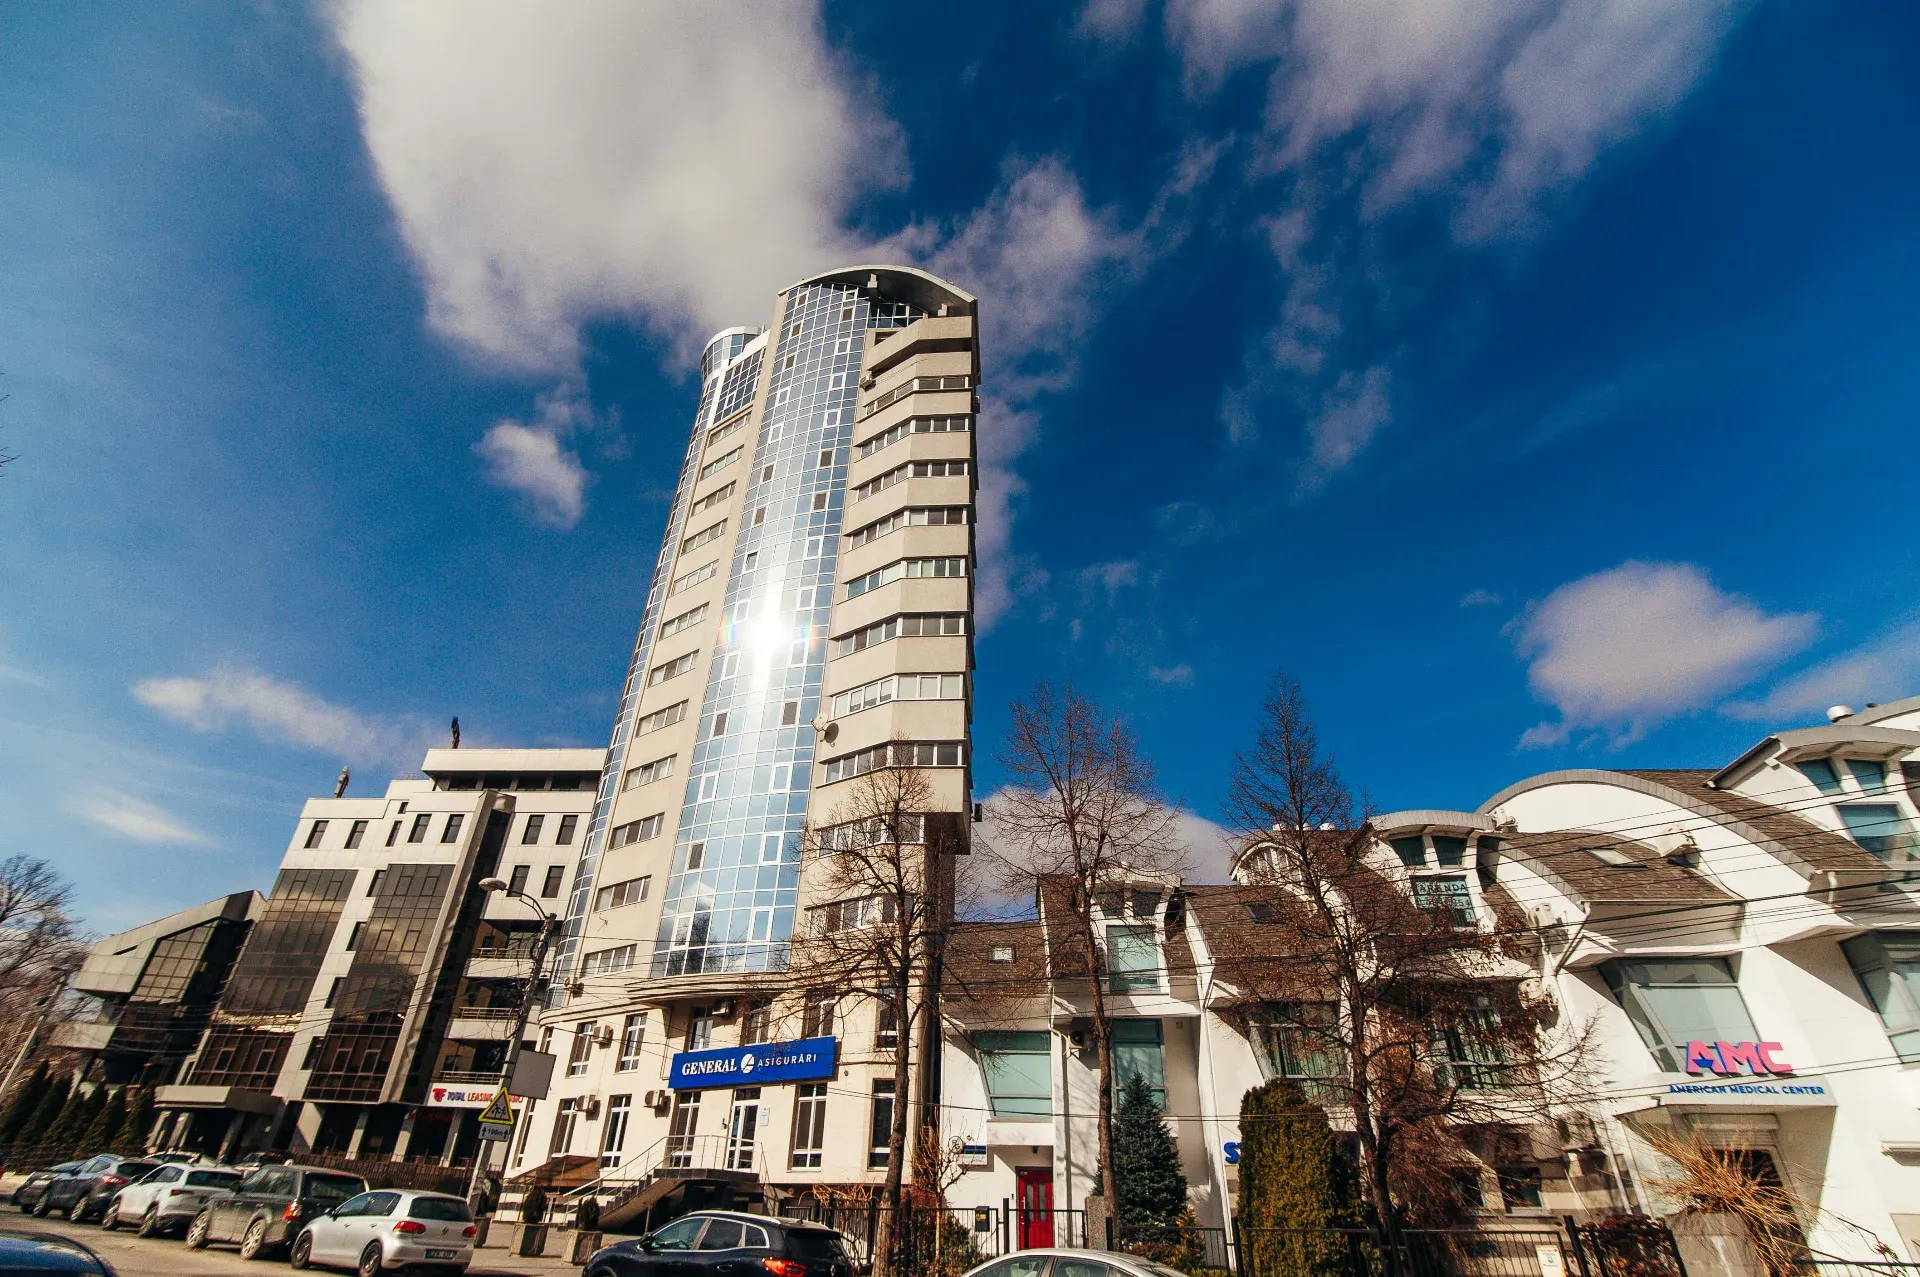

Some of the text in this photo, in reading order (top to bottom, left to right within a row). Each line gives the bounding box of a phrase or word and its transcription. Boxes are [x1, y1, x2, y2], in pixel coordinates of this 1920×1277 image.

[1686, 1041, 1793, 1075] AMC
[681, 1058, 738, 1076] GENERAL
[1669, 1084, 1825, 1095] AMERICAN MEDICAL CENTER
[447, 1091, 466, 1101] TOTAL
[488, 1128, 503, 1136] 100m
